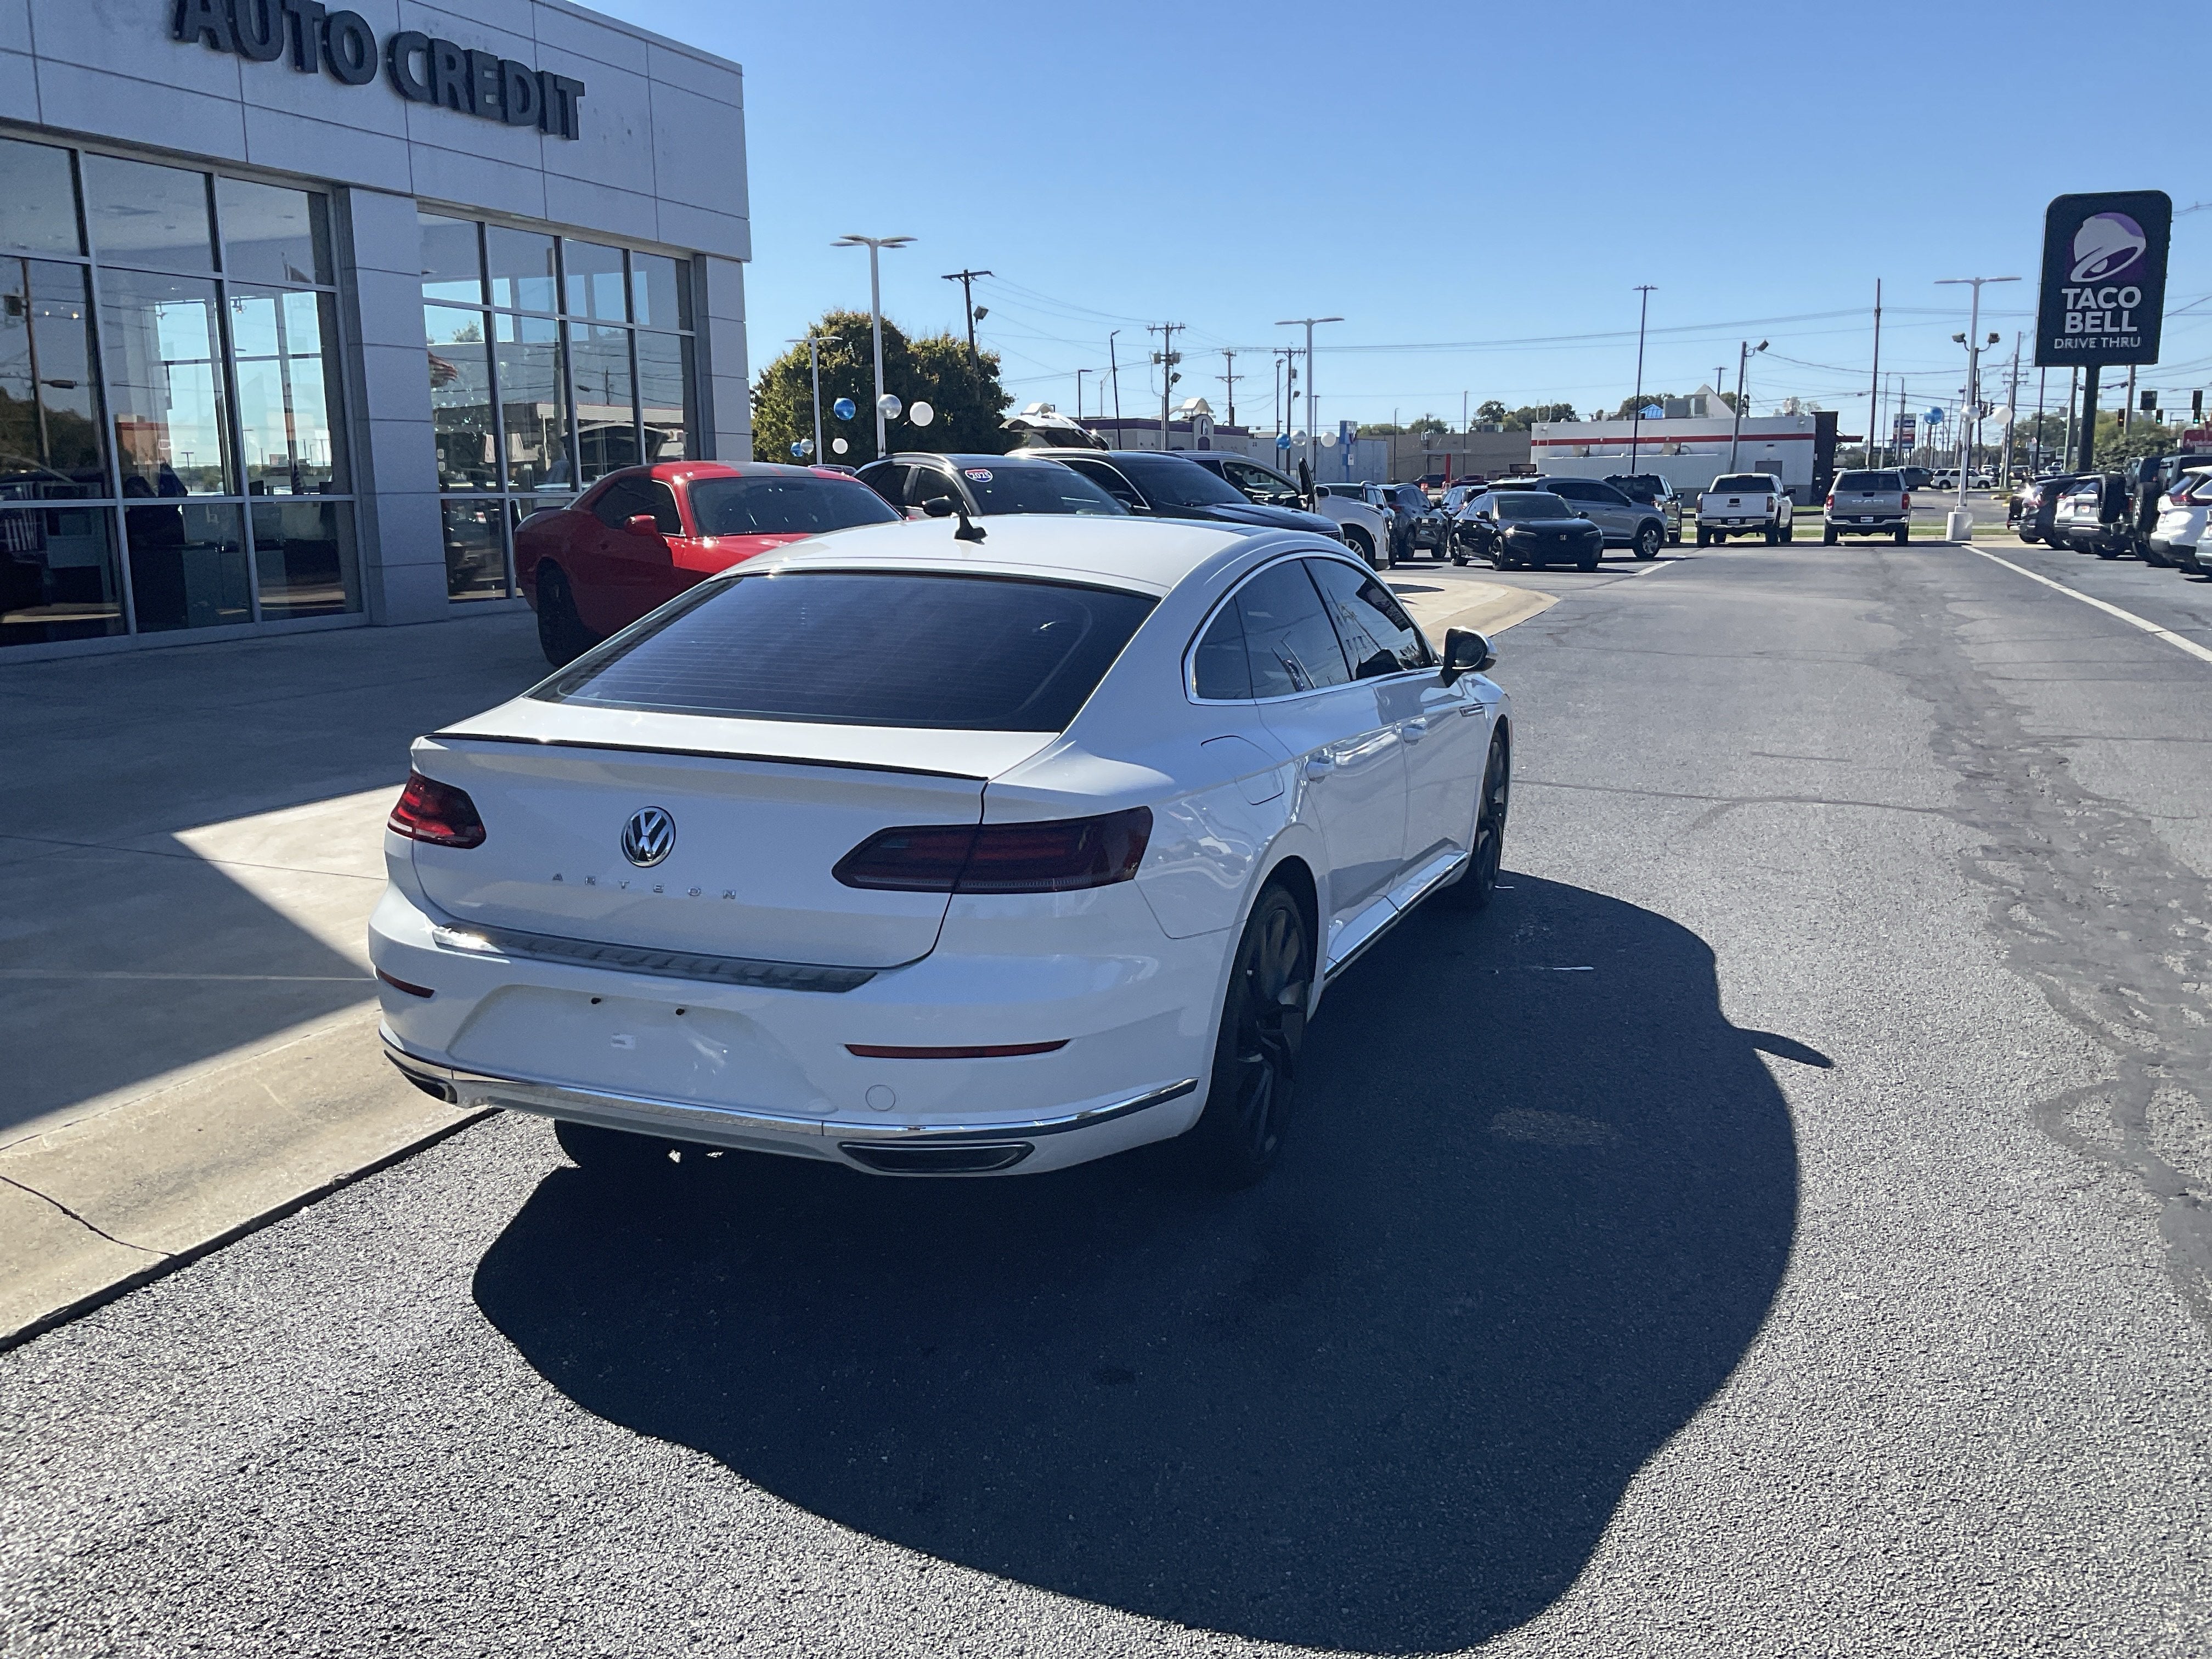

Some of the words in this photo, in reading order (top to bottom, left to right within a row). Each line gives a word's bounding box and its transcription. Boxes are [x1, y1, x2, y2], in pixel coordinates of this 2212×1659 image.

[171, 0, 379, 86] AUTO
[386, 30, 586, 141] CREDIT
[2062, 286, 2141, 309] TACO
[2064, 311, 2137, 333] BELL
[2054, 337, 2098, 349] DRIVE
[2101, 336, 2141, 348] THRU
[552, 873, 736, 900] ARTEON
